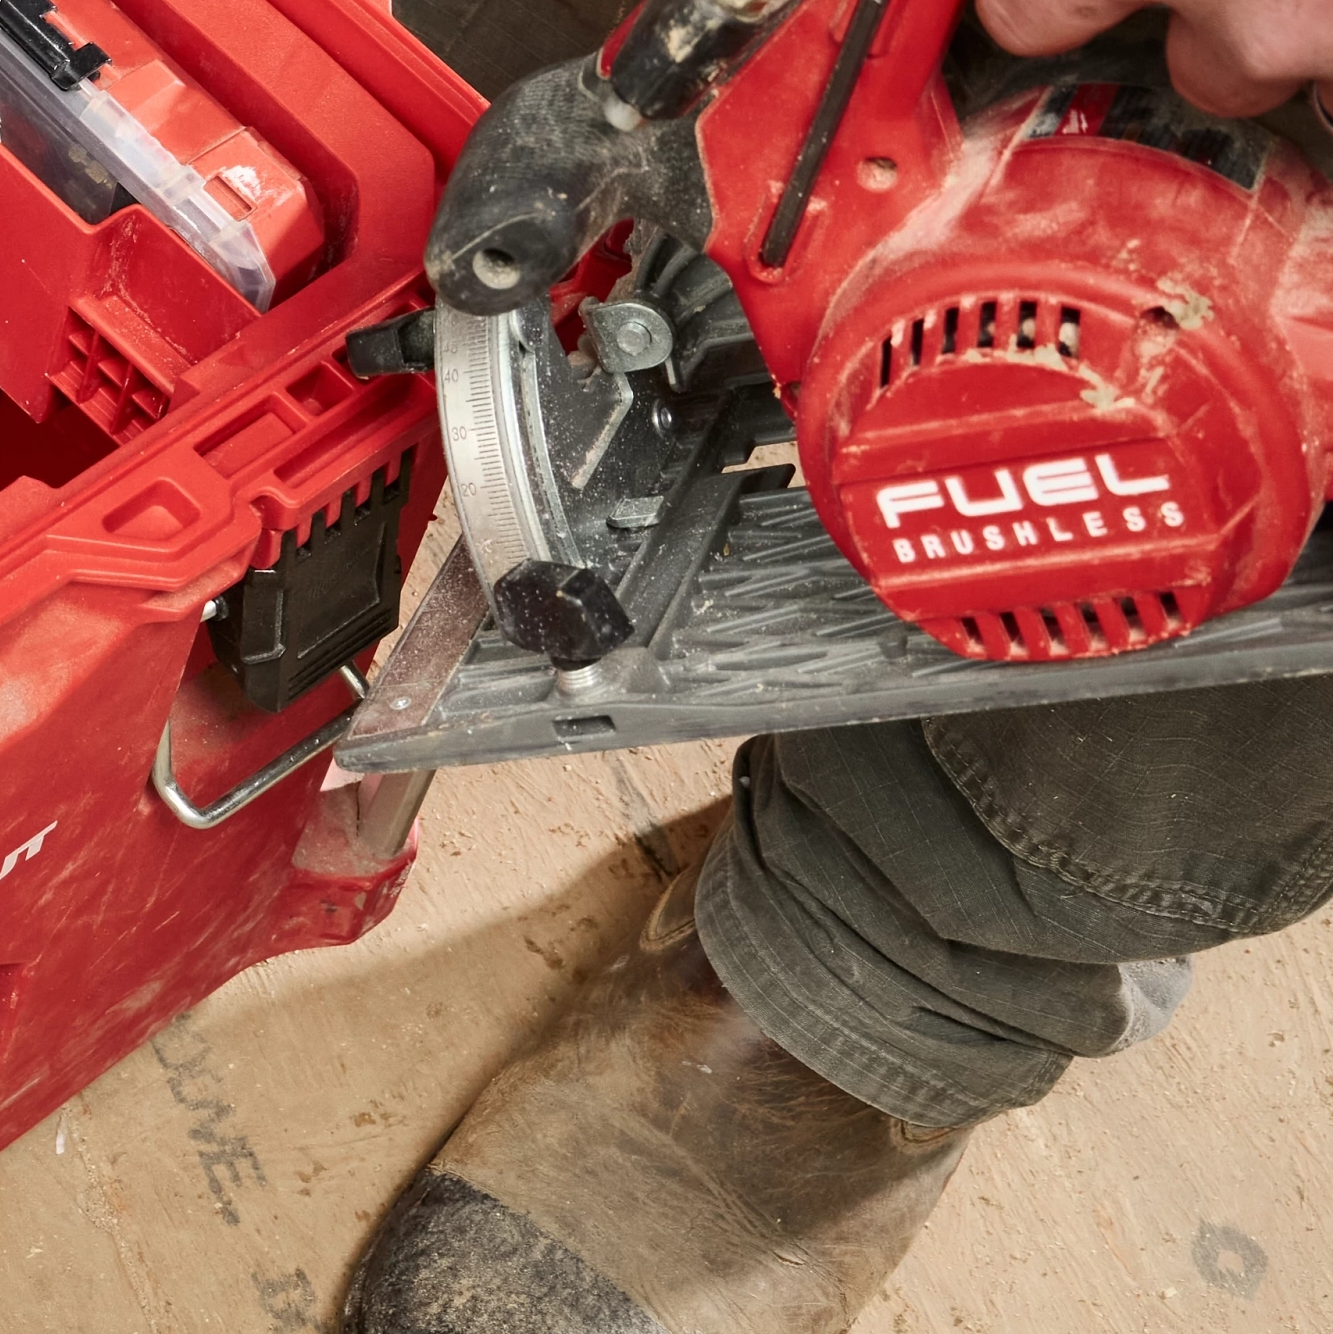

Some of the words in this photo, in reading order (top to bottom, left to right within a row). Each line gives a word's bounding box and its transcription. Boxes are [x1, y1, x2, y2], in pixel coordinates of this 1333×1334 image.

[443, 368, 459, 383] 40
[451, 425, 468, 442] 30
[461, 482, 477, 497] 20
[874, 453, 1171, 529] FUEL
[891, 501, 1186, 565] BRUSHLESS
